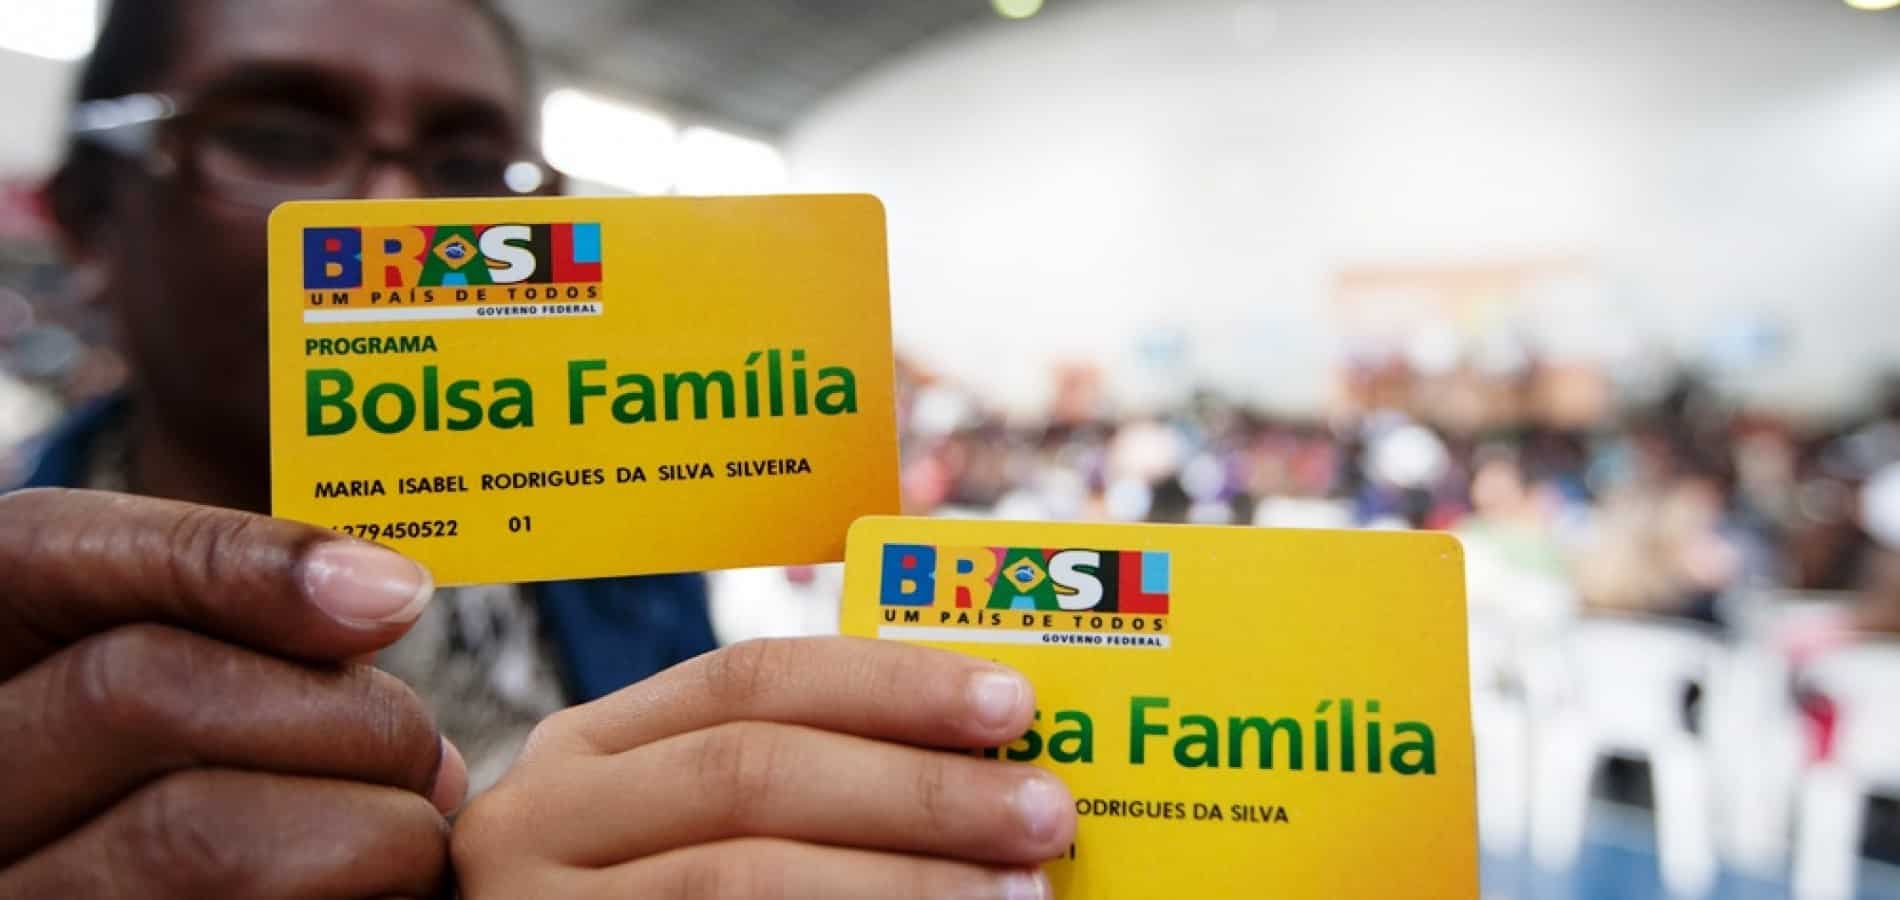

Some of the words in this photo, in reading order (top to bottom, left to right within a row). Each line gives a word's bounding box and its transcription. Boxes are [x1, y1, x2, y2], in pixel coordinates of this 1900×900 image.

[303, 222, 602, 289] BRASIL
[311, 292, 348, 305] UM
[371, 288, 434, 304] PAÍS
[456, 287, 487, 301] DE
[507, 286, 597, 300] TODOS
[477, 306, 537, 316] GOVERNO
[543, 304, 597, 314] FEDERAL
[305, 335, 438, 356] PROGRAMA
[306, 365, 534, 436] Bolsa
[568, 348, 858, 425] Família
[314, 479, 386, 498] MARIA
[398, 475, 468, 494] ISABEL
[481, 468, 605, 491] RODRIGUES
[616, 466, 646, 483] DA
[658, 463, 715, 481] SILVA
[726, 458, 812, 477] SILVEIRA
[332, 519, 458, 540] 79450522
[508, 515, 532, 533] 01
[880, 543, 1169, 614] BRASIL
[884, 609, 919, 622] UM
[940, 609, 1001, 626] PAÍS
[1022, 614, 1053, 627] DE
[1073, 616, 1163, 631] TODOS
[1042, 633, 1103, 644] GOVERNO
[1106, 636, 1163, 647] FEDERAL
[1129, 696, 1436, 775] Família
[1074, 798, 1186, 819] ODRIGUES
[1193, 802, 1223, 821] DA
[1230, 804, 1289, 823] SILVA
